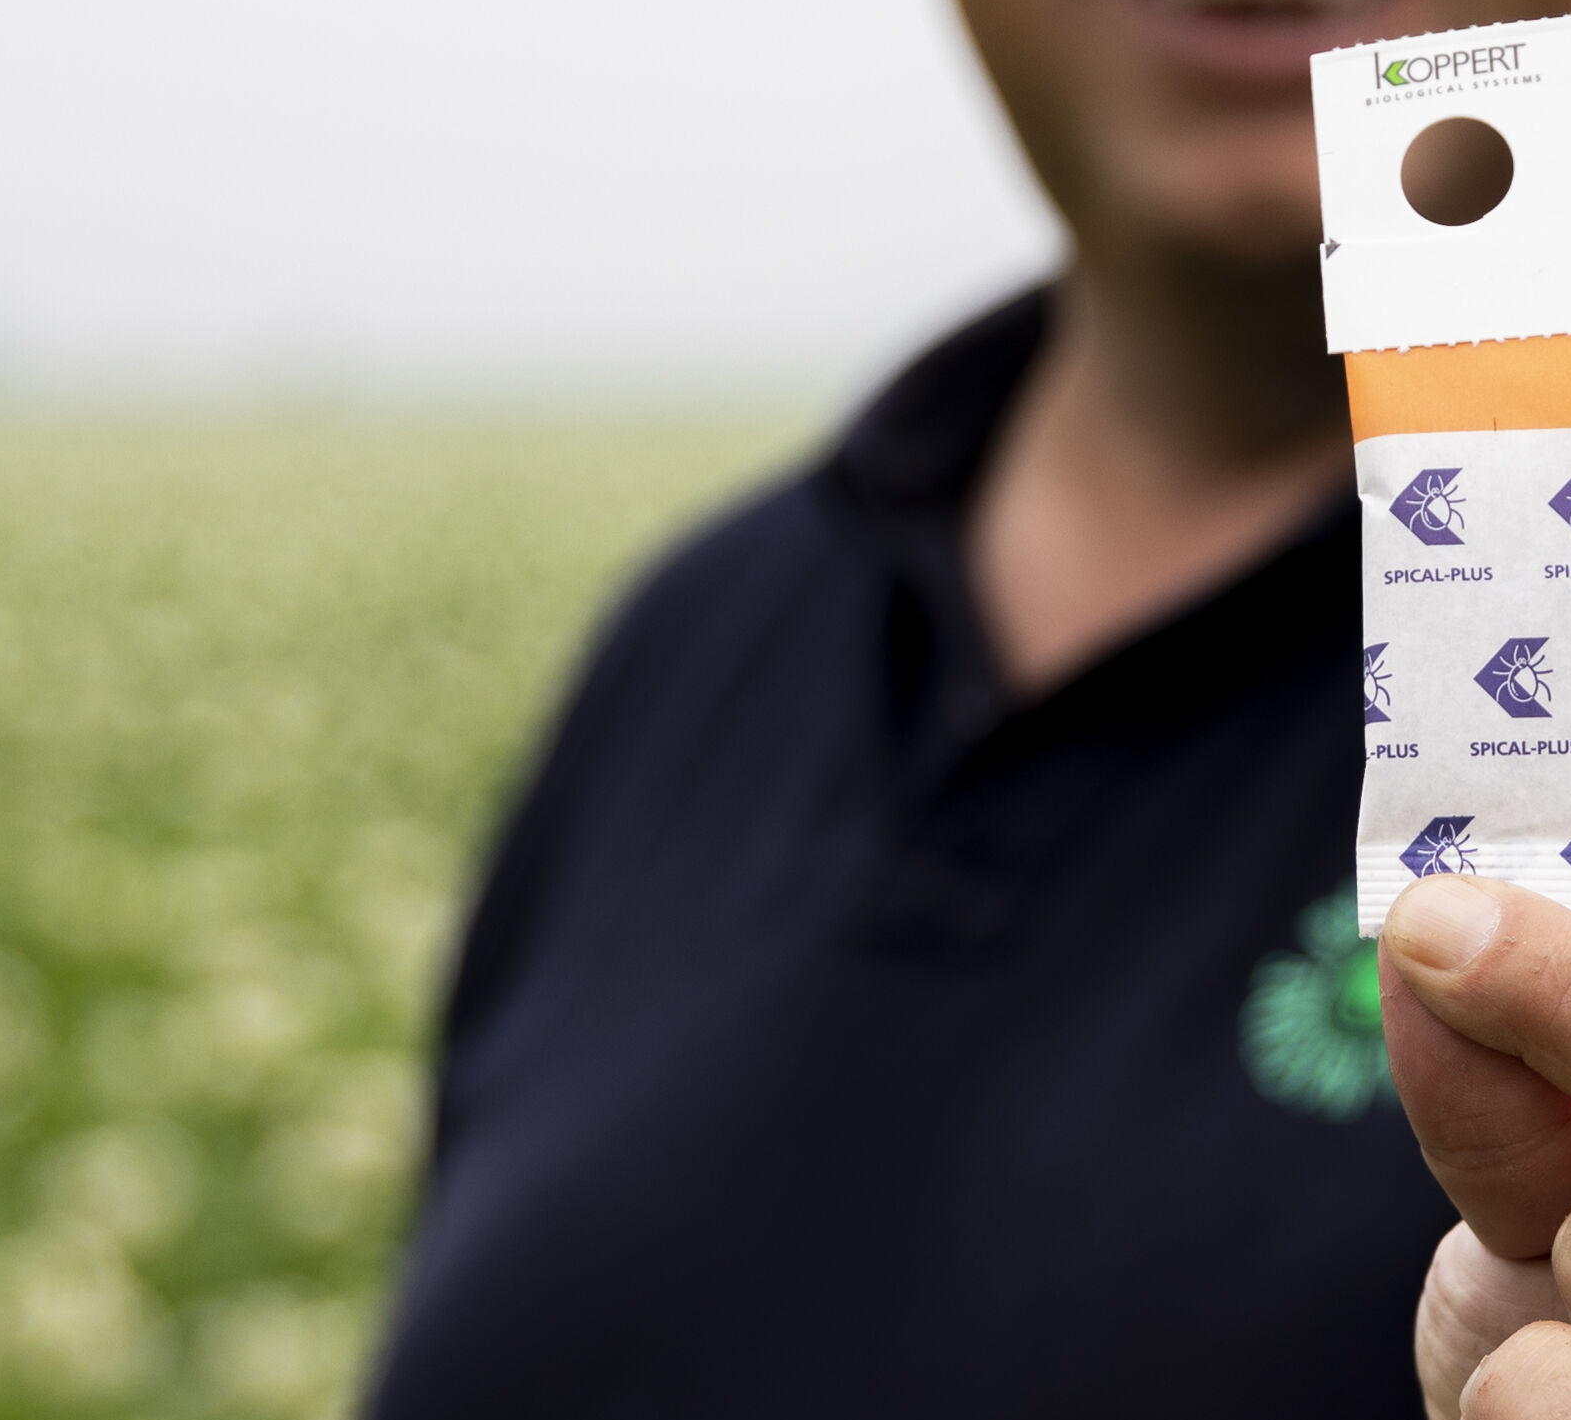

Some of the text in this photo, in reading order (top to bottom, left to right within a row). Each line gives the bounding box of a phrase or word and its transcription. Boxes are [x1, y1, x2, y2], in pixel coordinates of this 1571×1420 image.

[1374, 43, 1526, 89] KOPPERT
[1366, 74, 1542, 106] BIOLOGICAL SYSTEMS
[1384, 567, 1493, 585] SPICAL-PLUS
[1366, 743, 1419, 760] -PLUS
